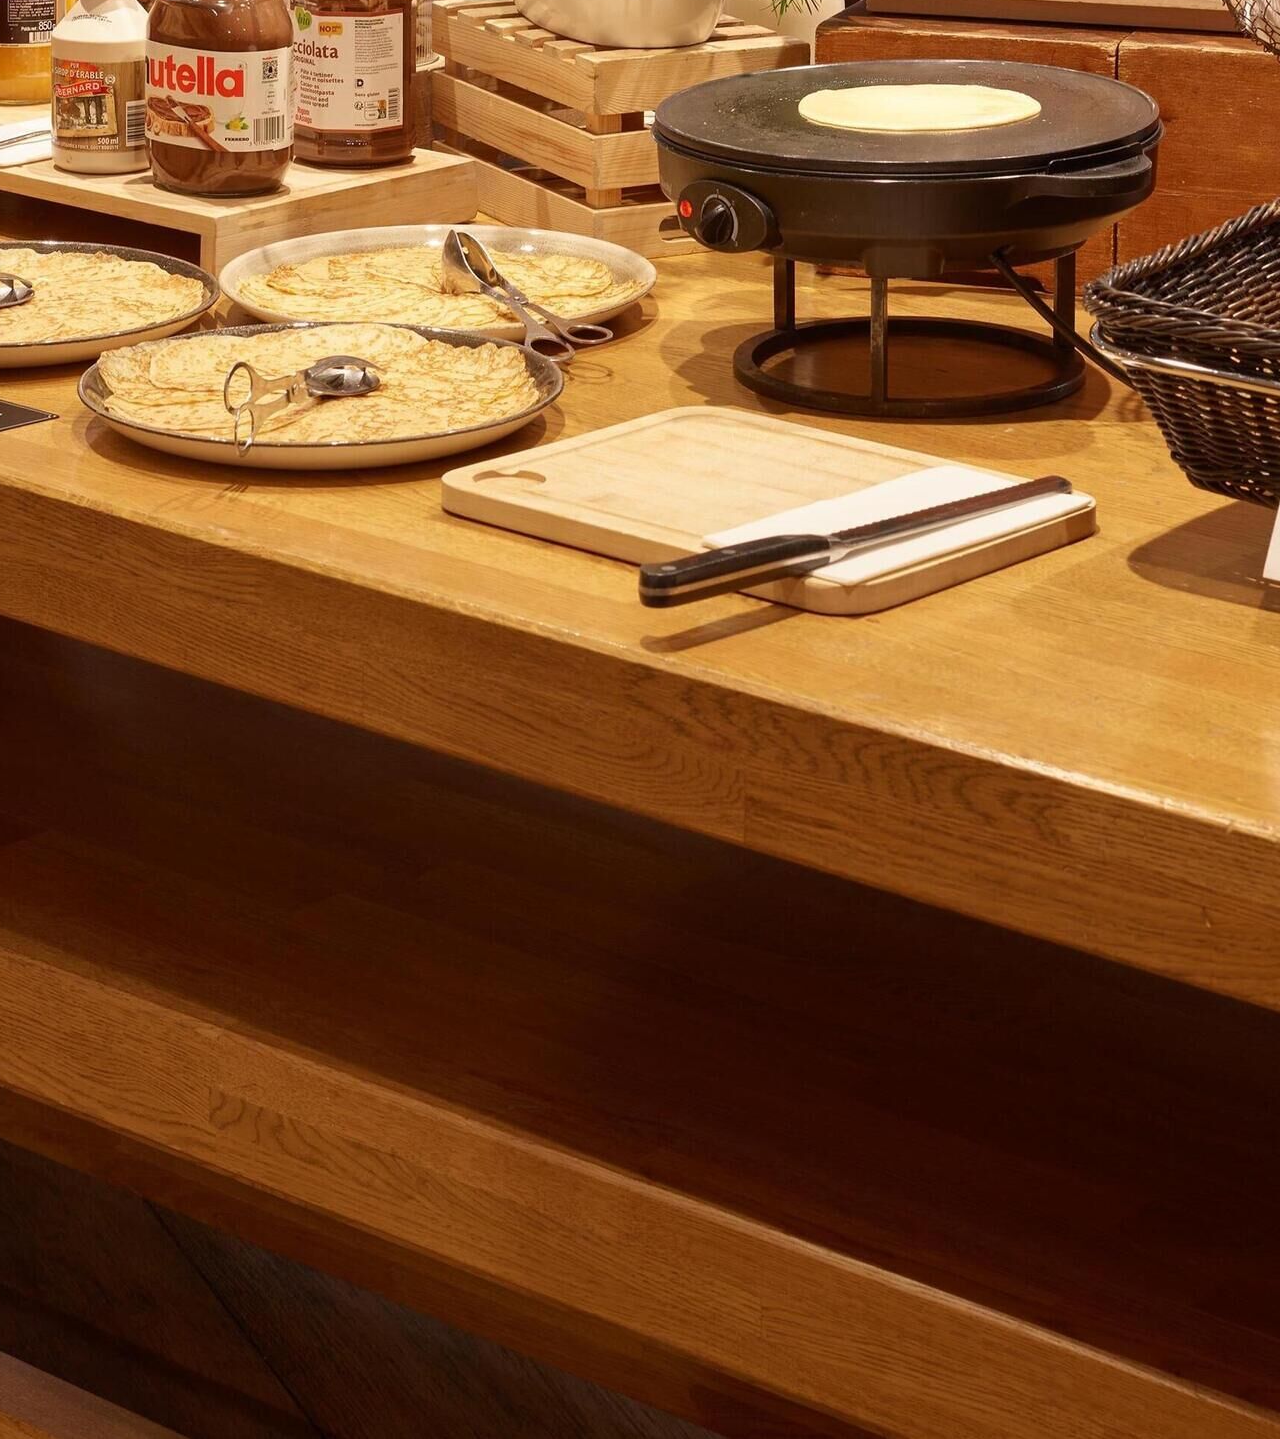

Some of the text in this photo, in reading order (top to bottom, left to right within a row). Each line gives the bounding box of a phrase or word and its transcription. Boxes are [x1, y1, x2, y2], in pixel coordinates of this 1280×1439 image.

[319, 25, 332, 33] NO
[293, 39, 339, 59] cciolata
[57, 82, 101, 96] BERNARD
[97, 137, 119, 145] 500 ml
